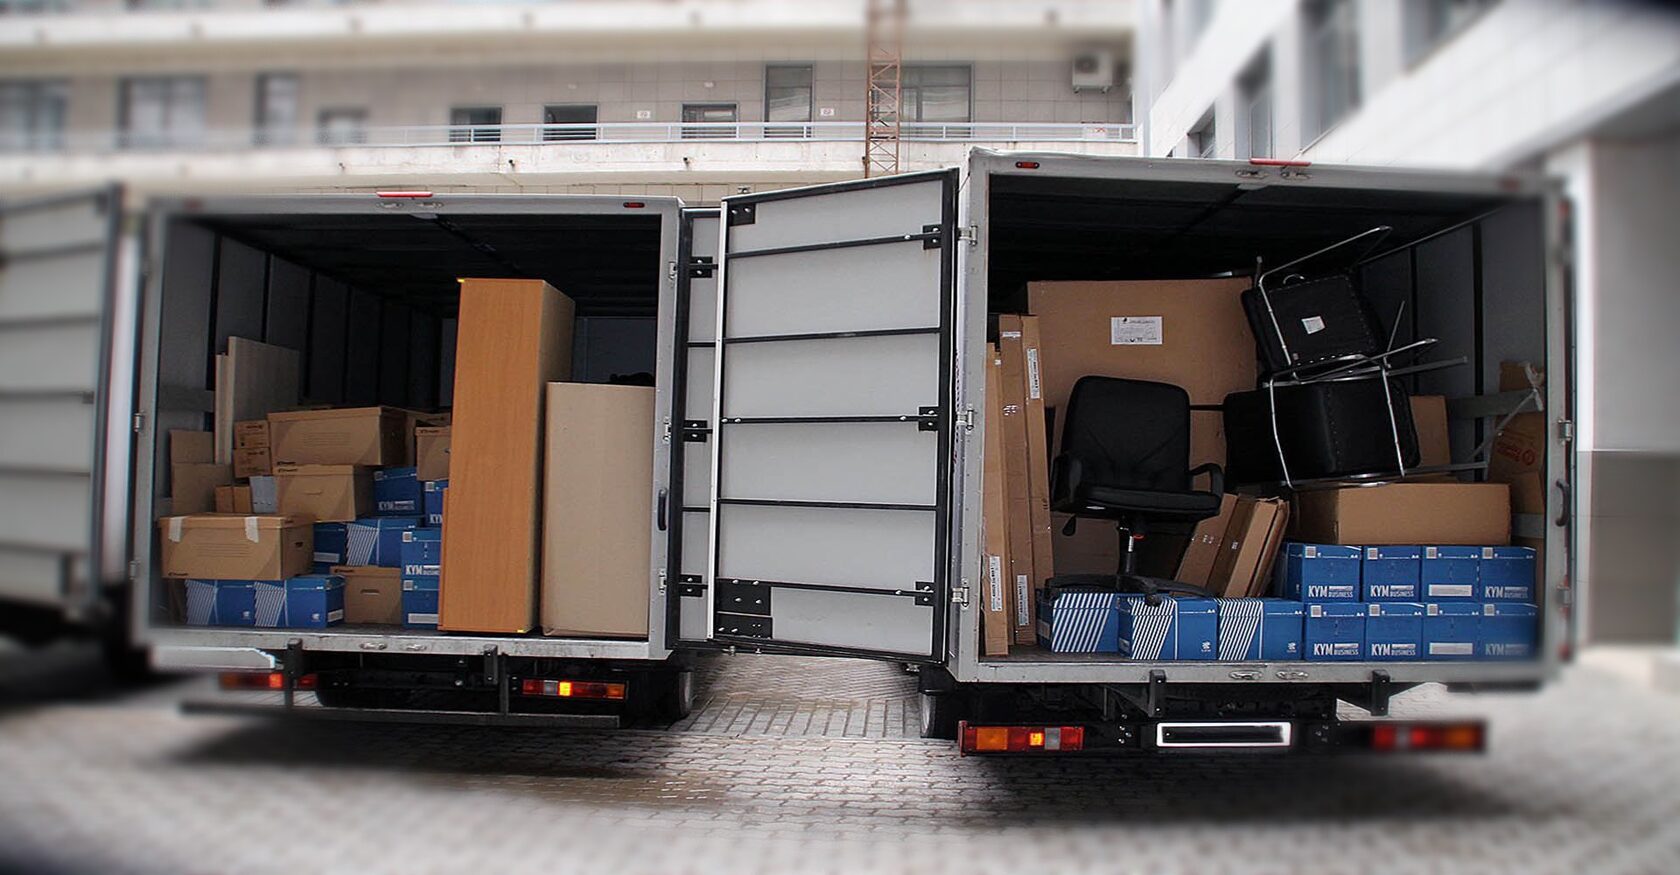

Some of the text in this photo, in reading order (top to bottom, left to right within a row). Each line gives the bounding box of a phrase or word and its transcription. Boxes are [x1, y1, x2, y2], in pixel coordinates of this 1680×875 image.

[405, 565, 422, 575] KYM
[1308, 585, 1328, 598] KYM
[1370, 585, 1389, 597] KYM
[1485, 586, 1504, 598] KYM
[1314, 644, 1333, 656] KYM
[1372, 644, 1390, 656] KYM
[1485, 644, 1504, 656] KYM
